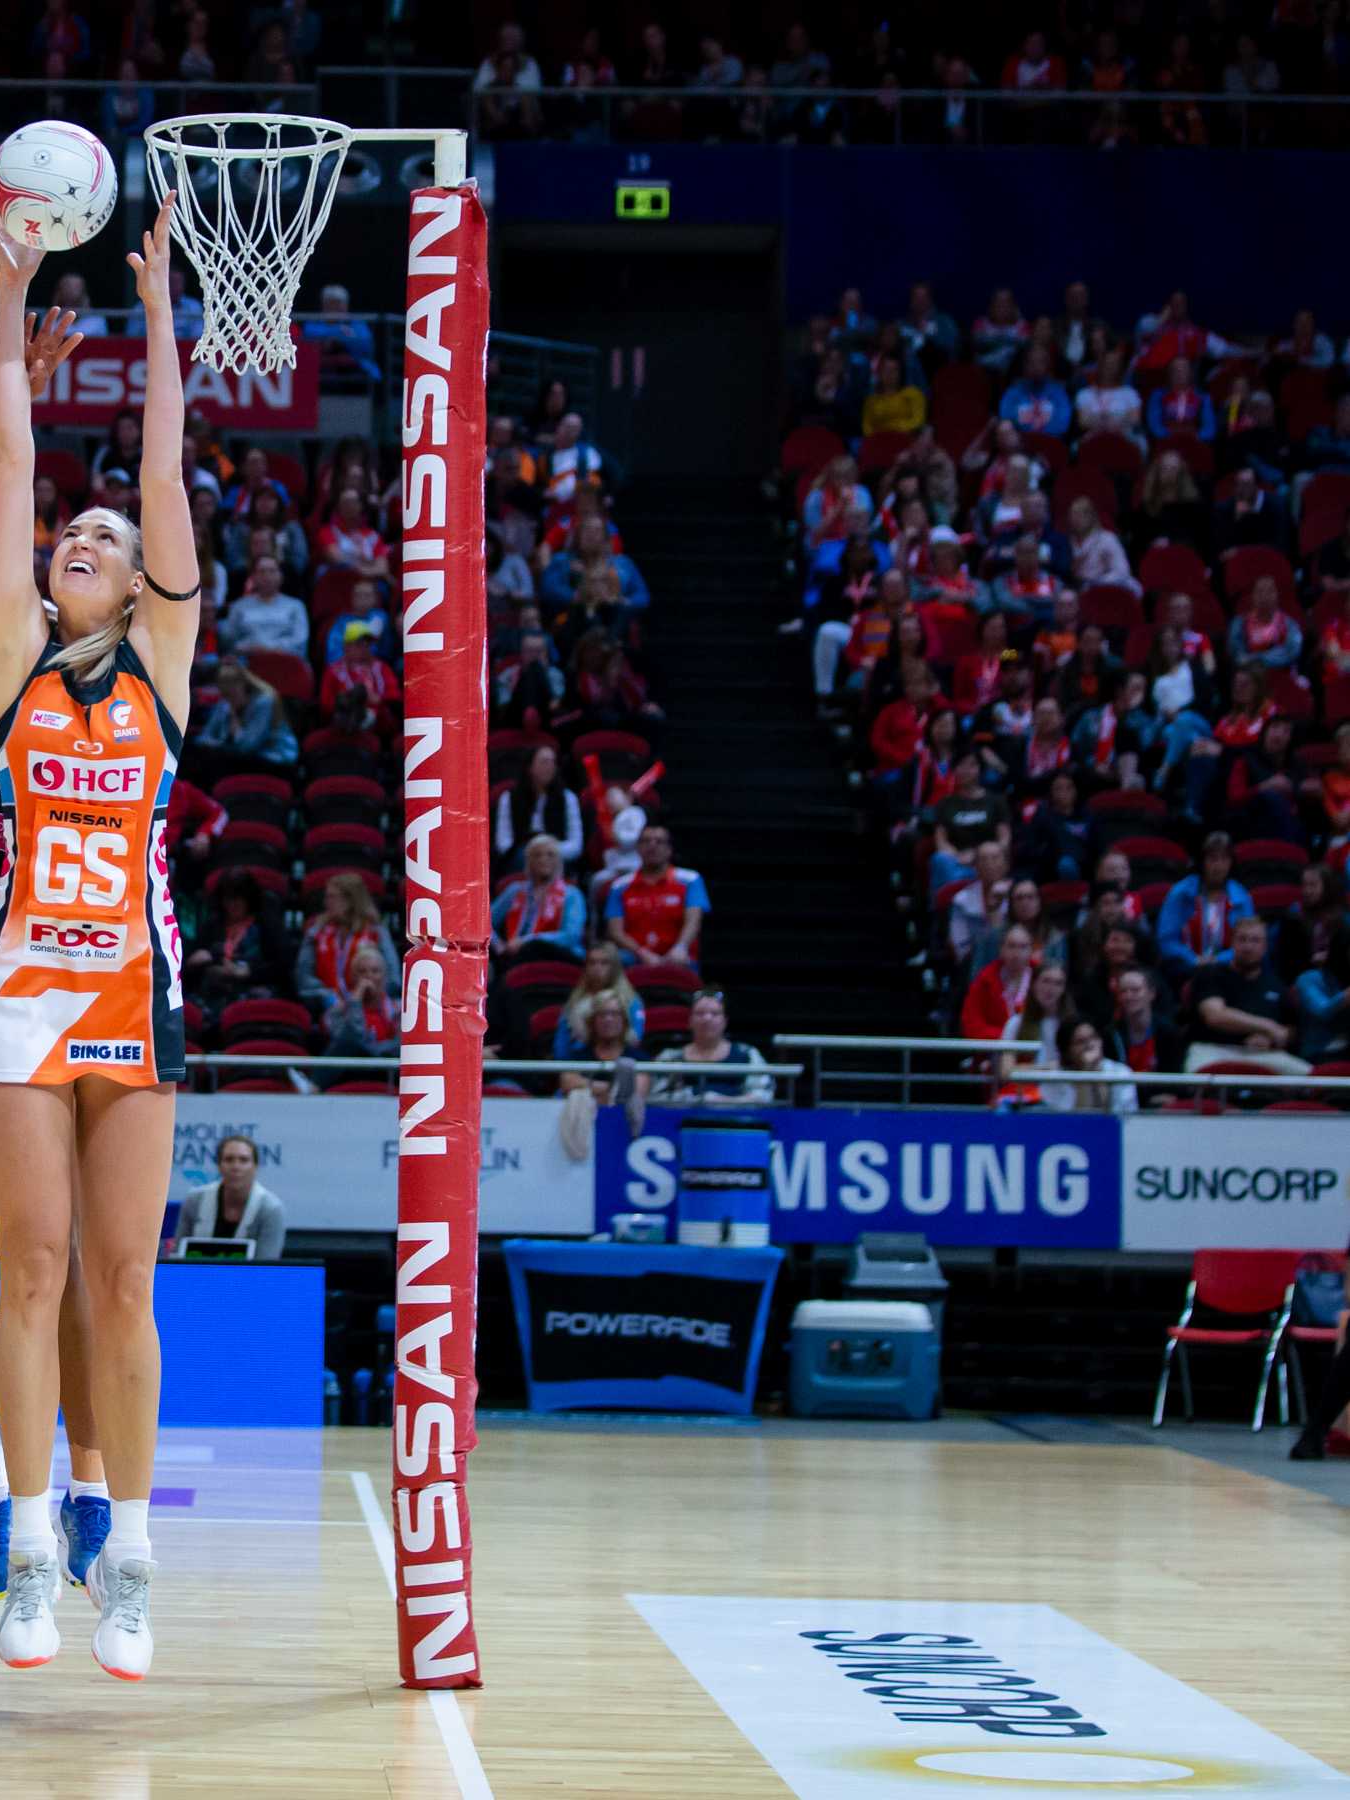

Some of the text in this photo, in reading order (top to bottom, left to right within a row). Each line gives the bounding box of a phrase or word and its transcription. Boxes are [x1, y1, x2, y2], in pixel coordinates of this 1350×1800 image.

[34, 358, 293, 408] ISAN
[402, 195, 462, 653] NISSAN
[72, 767, 141, 789] HCF
[50, 809, 123, 829] NISSAN
[34, 826, 129, 907] GS
[30, 944, 83, 958] construction
[94, 949, 117, 959] fitout
[31, 923, 120, 949] FDC
[69, 1044, 141, 1061] BING LEE
[626, 1136, 1090, 1216] SMSUNG
[1135, 1165, 1339, 1204] SUNCORP
[545, 1310, 732, 1348] POWERADE
[394, 1221, 477, 1682] NISSAN
[798, 1629, 1108, 1738] SUNCORP
